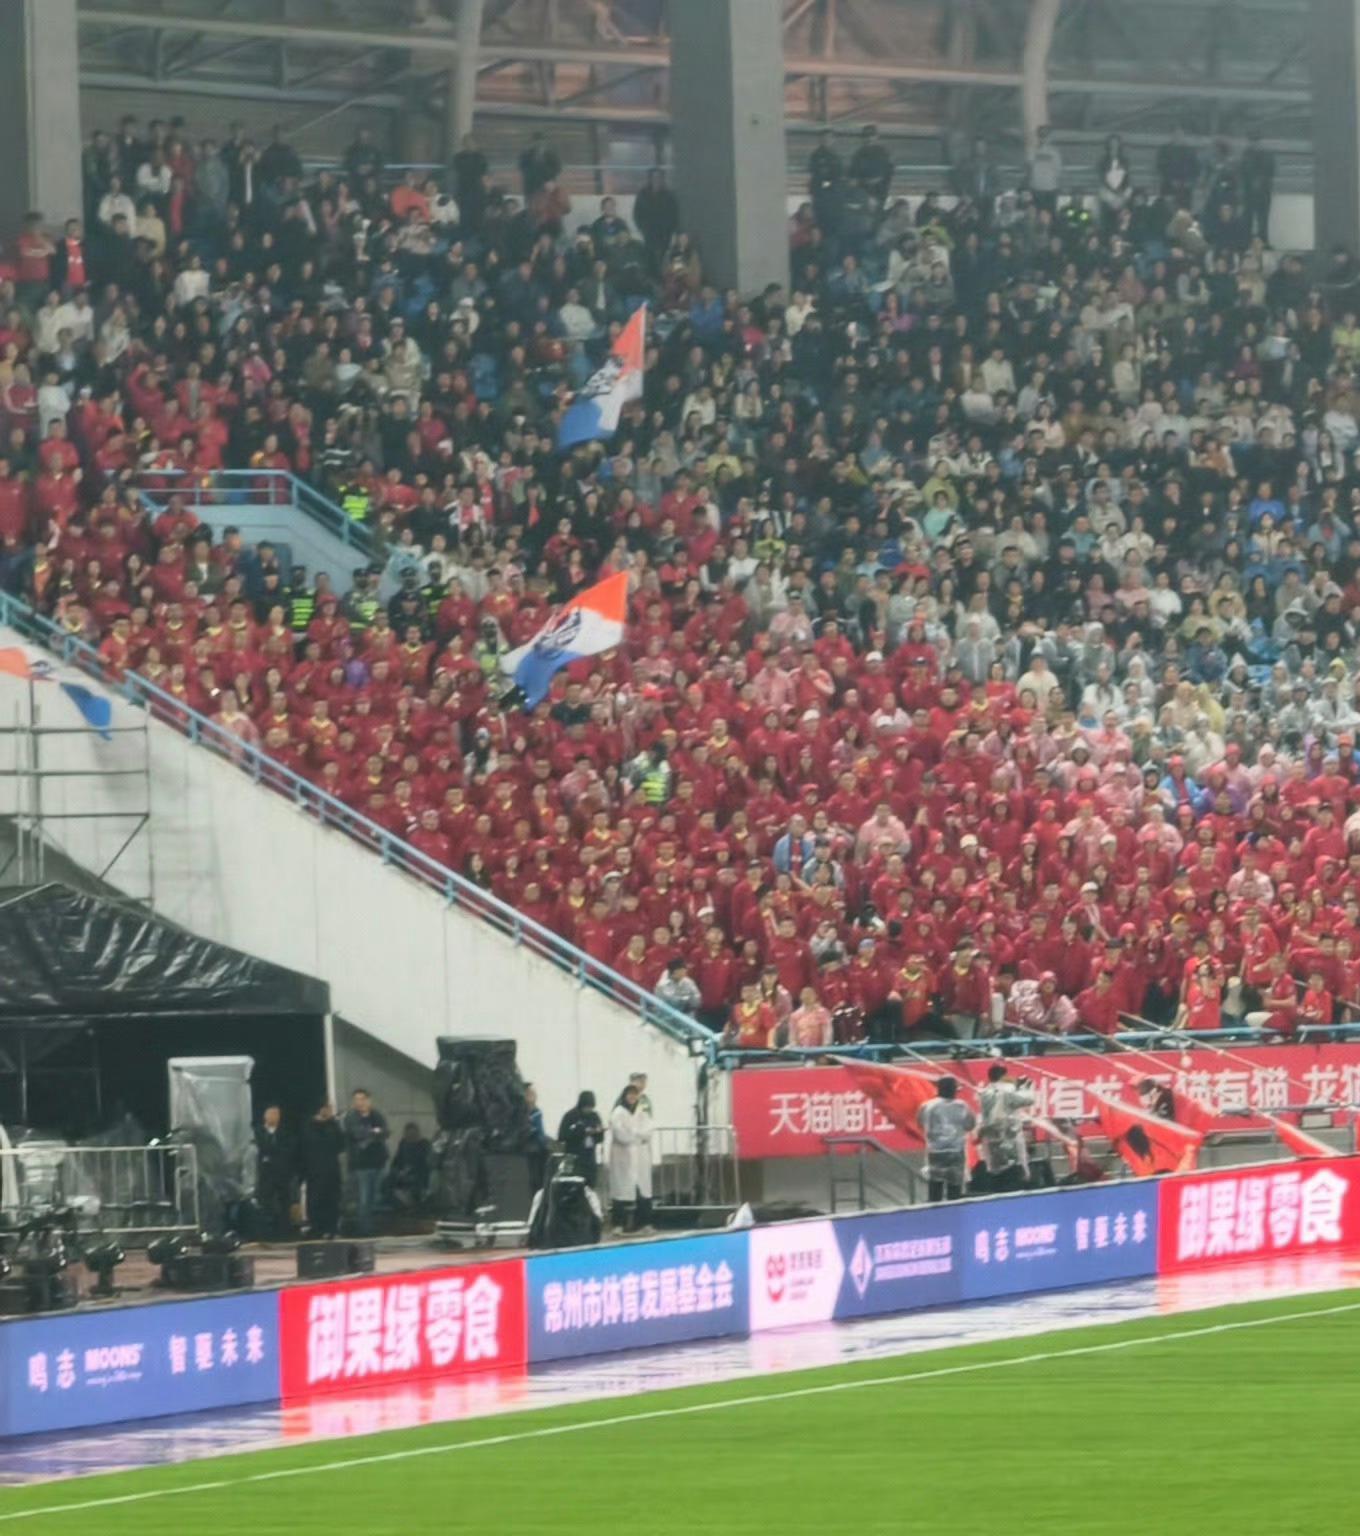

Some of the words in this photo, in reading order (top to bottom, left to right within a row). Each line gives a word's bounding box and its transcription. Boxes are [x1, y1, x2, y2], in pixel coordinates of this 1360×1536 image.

[542, 1261, 735, 1334] 常州市体育发展基金会
